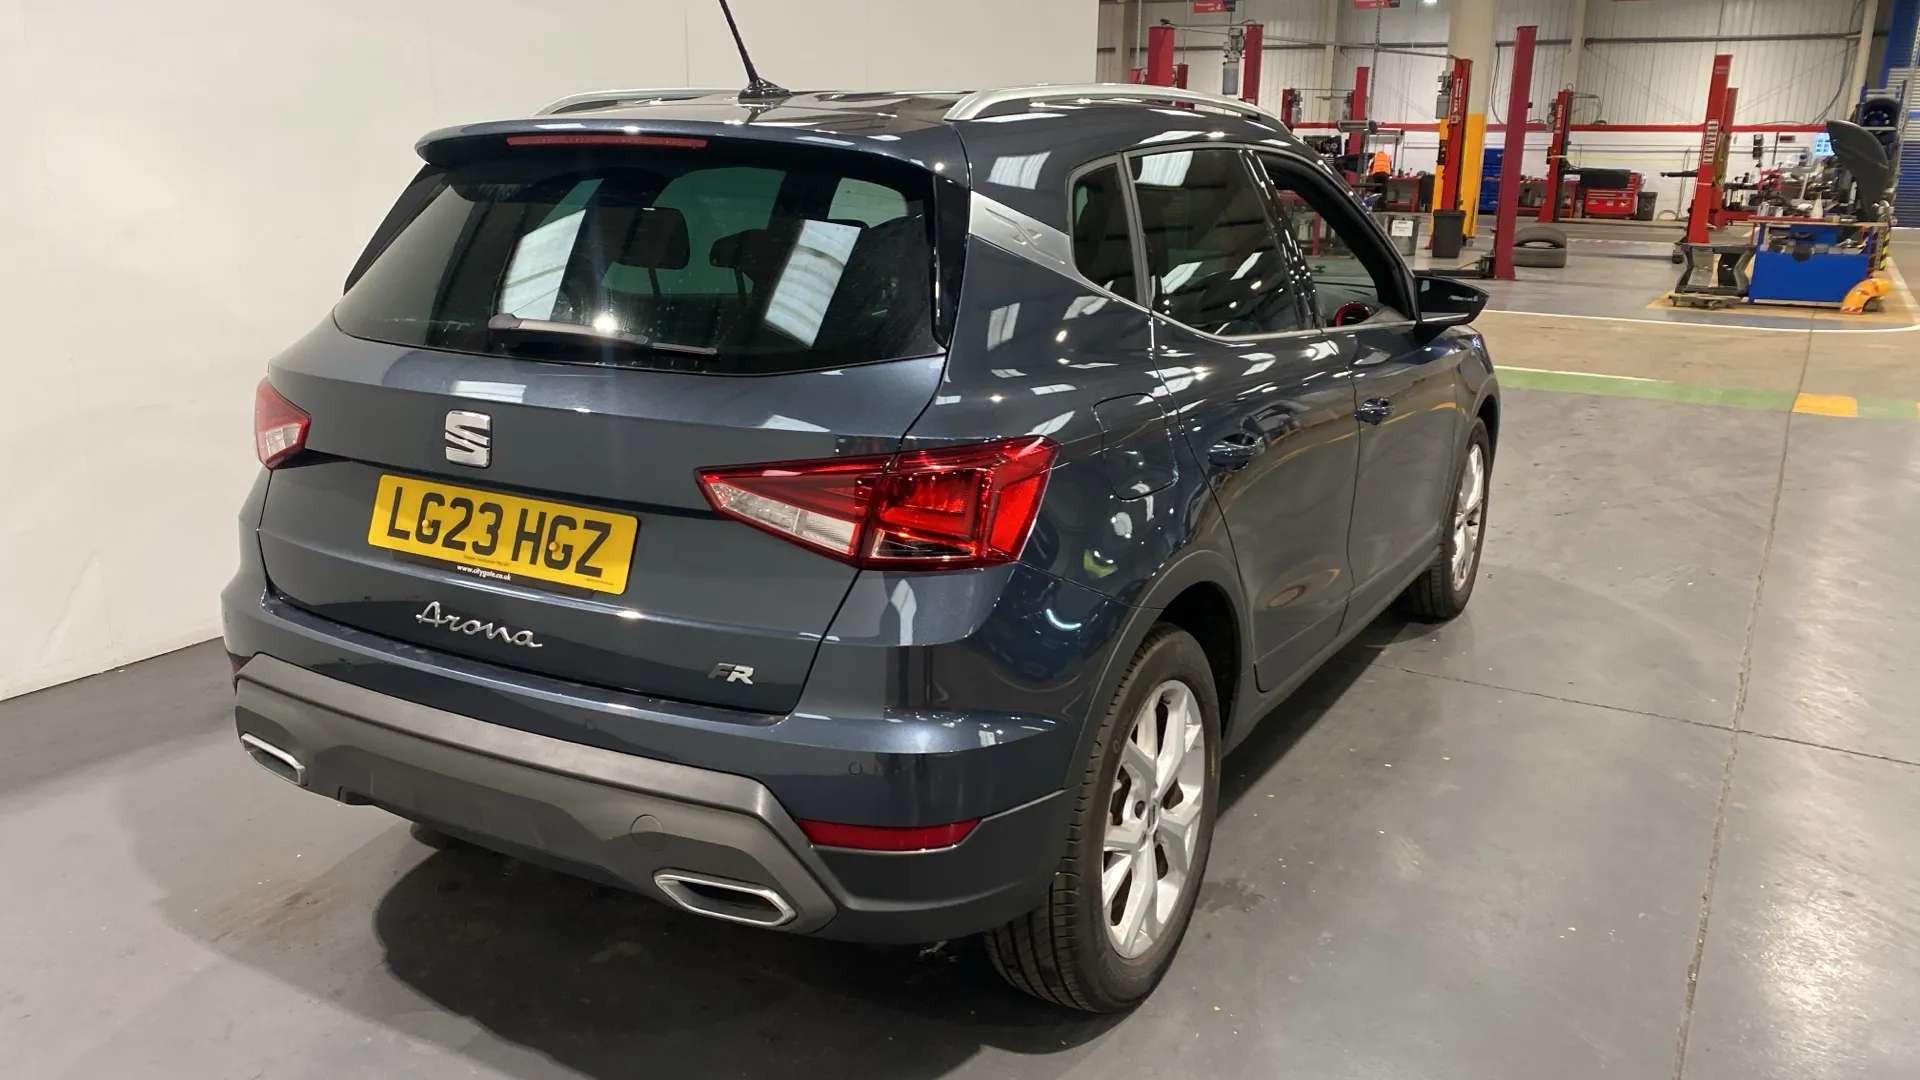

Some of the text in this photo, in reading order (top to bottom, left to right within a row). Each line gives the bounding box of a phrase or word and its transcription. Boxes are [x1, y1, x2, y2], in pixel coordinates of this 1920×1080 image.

[387, 486, 612, 578] LG23 HGZ
[456, 564, 512, 581] www.citygate.co.uk
[415, 601, 542, 648] Arona
[708, 662, 754, 685] FR
